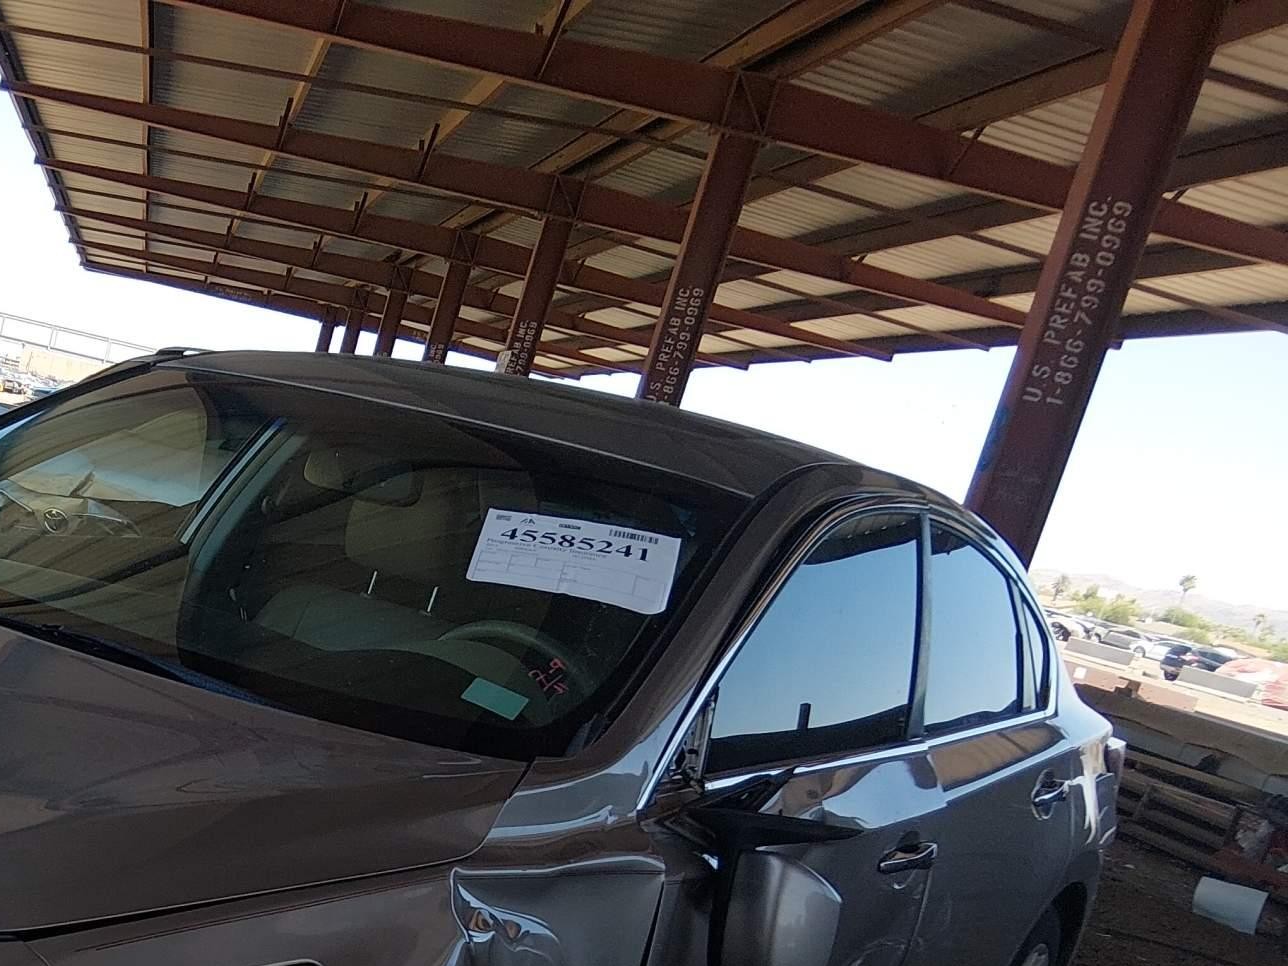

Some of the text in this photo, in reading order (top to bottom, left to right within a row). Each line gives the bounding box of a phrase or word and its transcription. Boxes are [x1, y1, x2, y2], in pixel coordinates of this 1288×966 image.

[1044, 252, 1091, 345] PREFAB
[1080, 195, 1113, 241] INC.
[1046, 201, 1133, 405] 1-866-799-0969
[655, 317, 681, 371] PREFAB
[674, 286, 693, 311] INC.
[662, 288, 704, 404] -866-799-0969
[500, 527, 650, 562] 45585241
